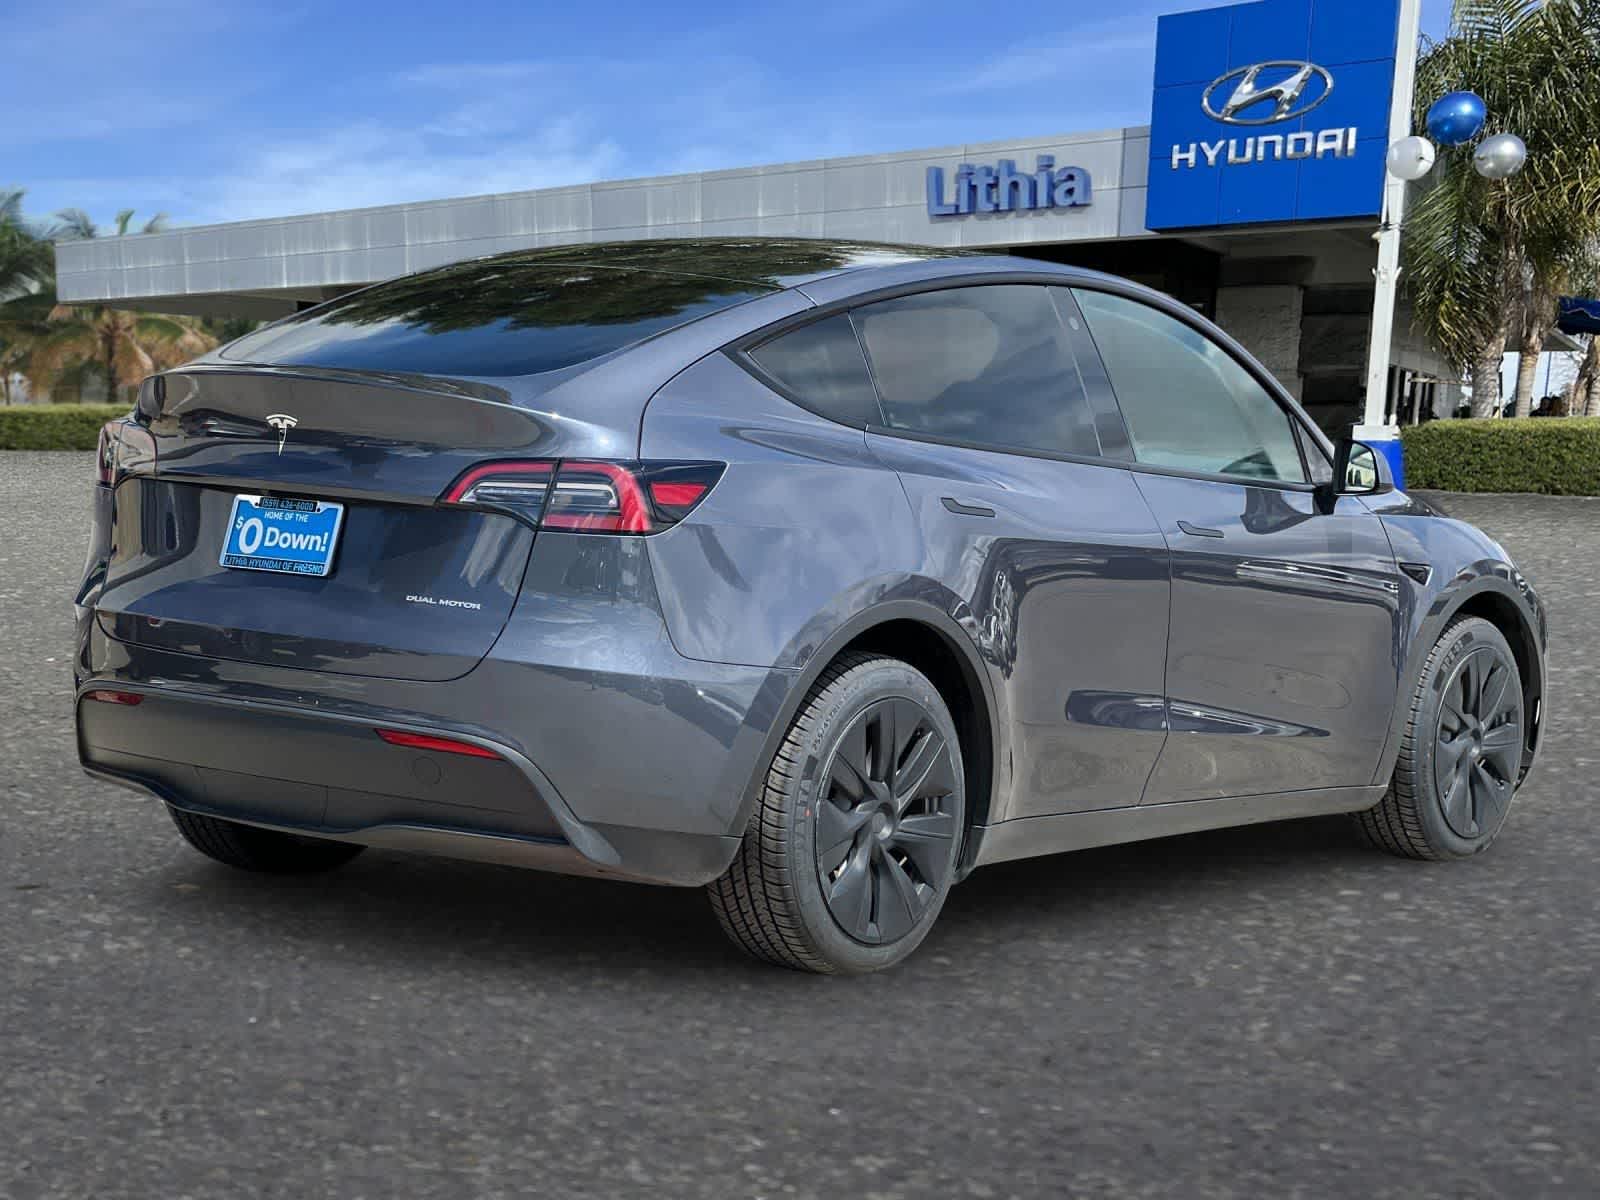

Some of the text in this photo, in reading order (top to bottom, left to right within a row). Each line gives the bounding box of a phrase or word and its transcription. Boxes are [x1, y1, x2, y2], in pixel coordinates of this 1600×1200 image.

[1171, 127, 1357, 169] HYUNDAI
[926, 154, 1092, 216] Lithia
[264, 511, 309, 523] HOME OF THE
[264, 527, 329, 552] Down!
[248, 557, 281, 570] HYUNDAI
[282, 561, 293, 571] OF
[293, 562, 323, 574] FRESNO
[406, 595, 481, 610] DUAL MOTOR
